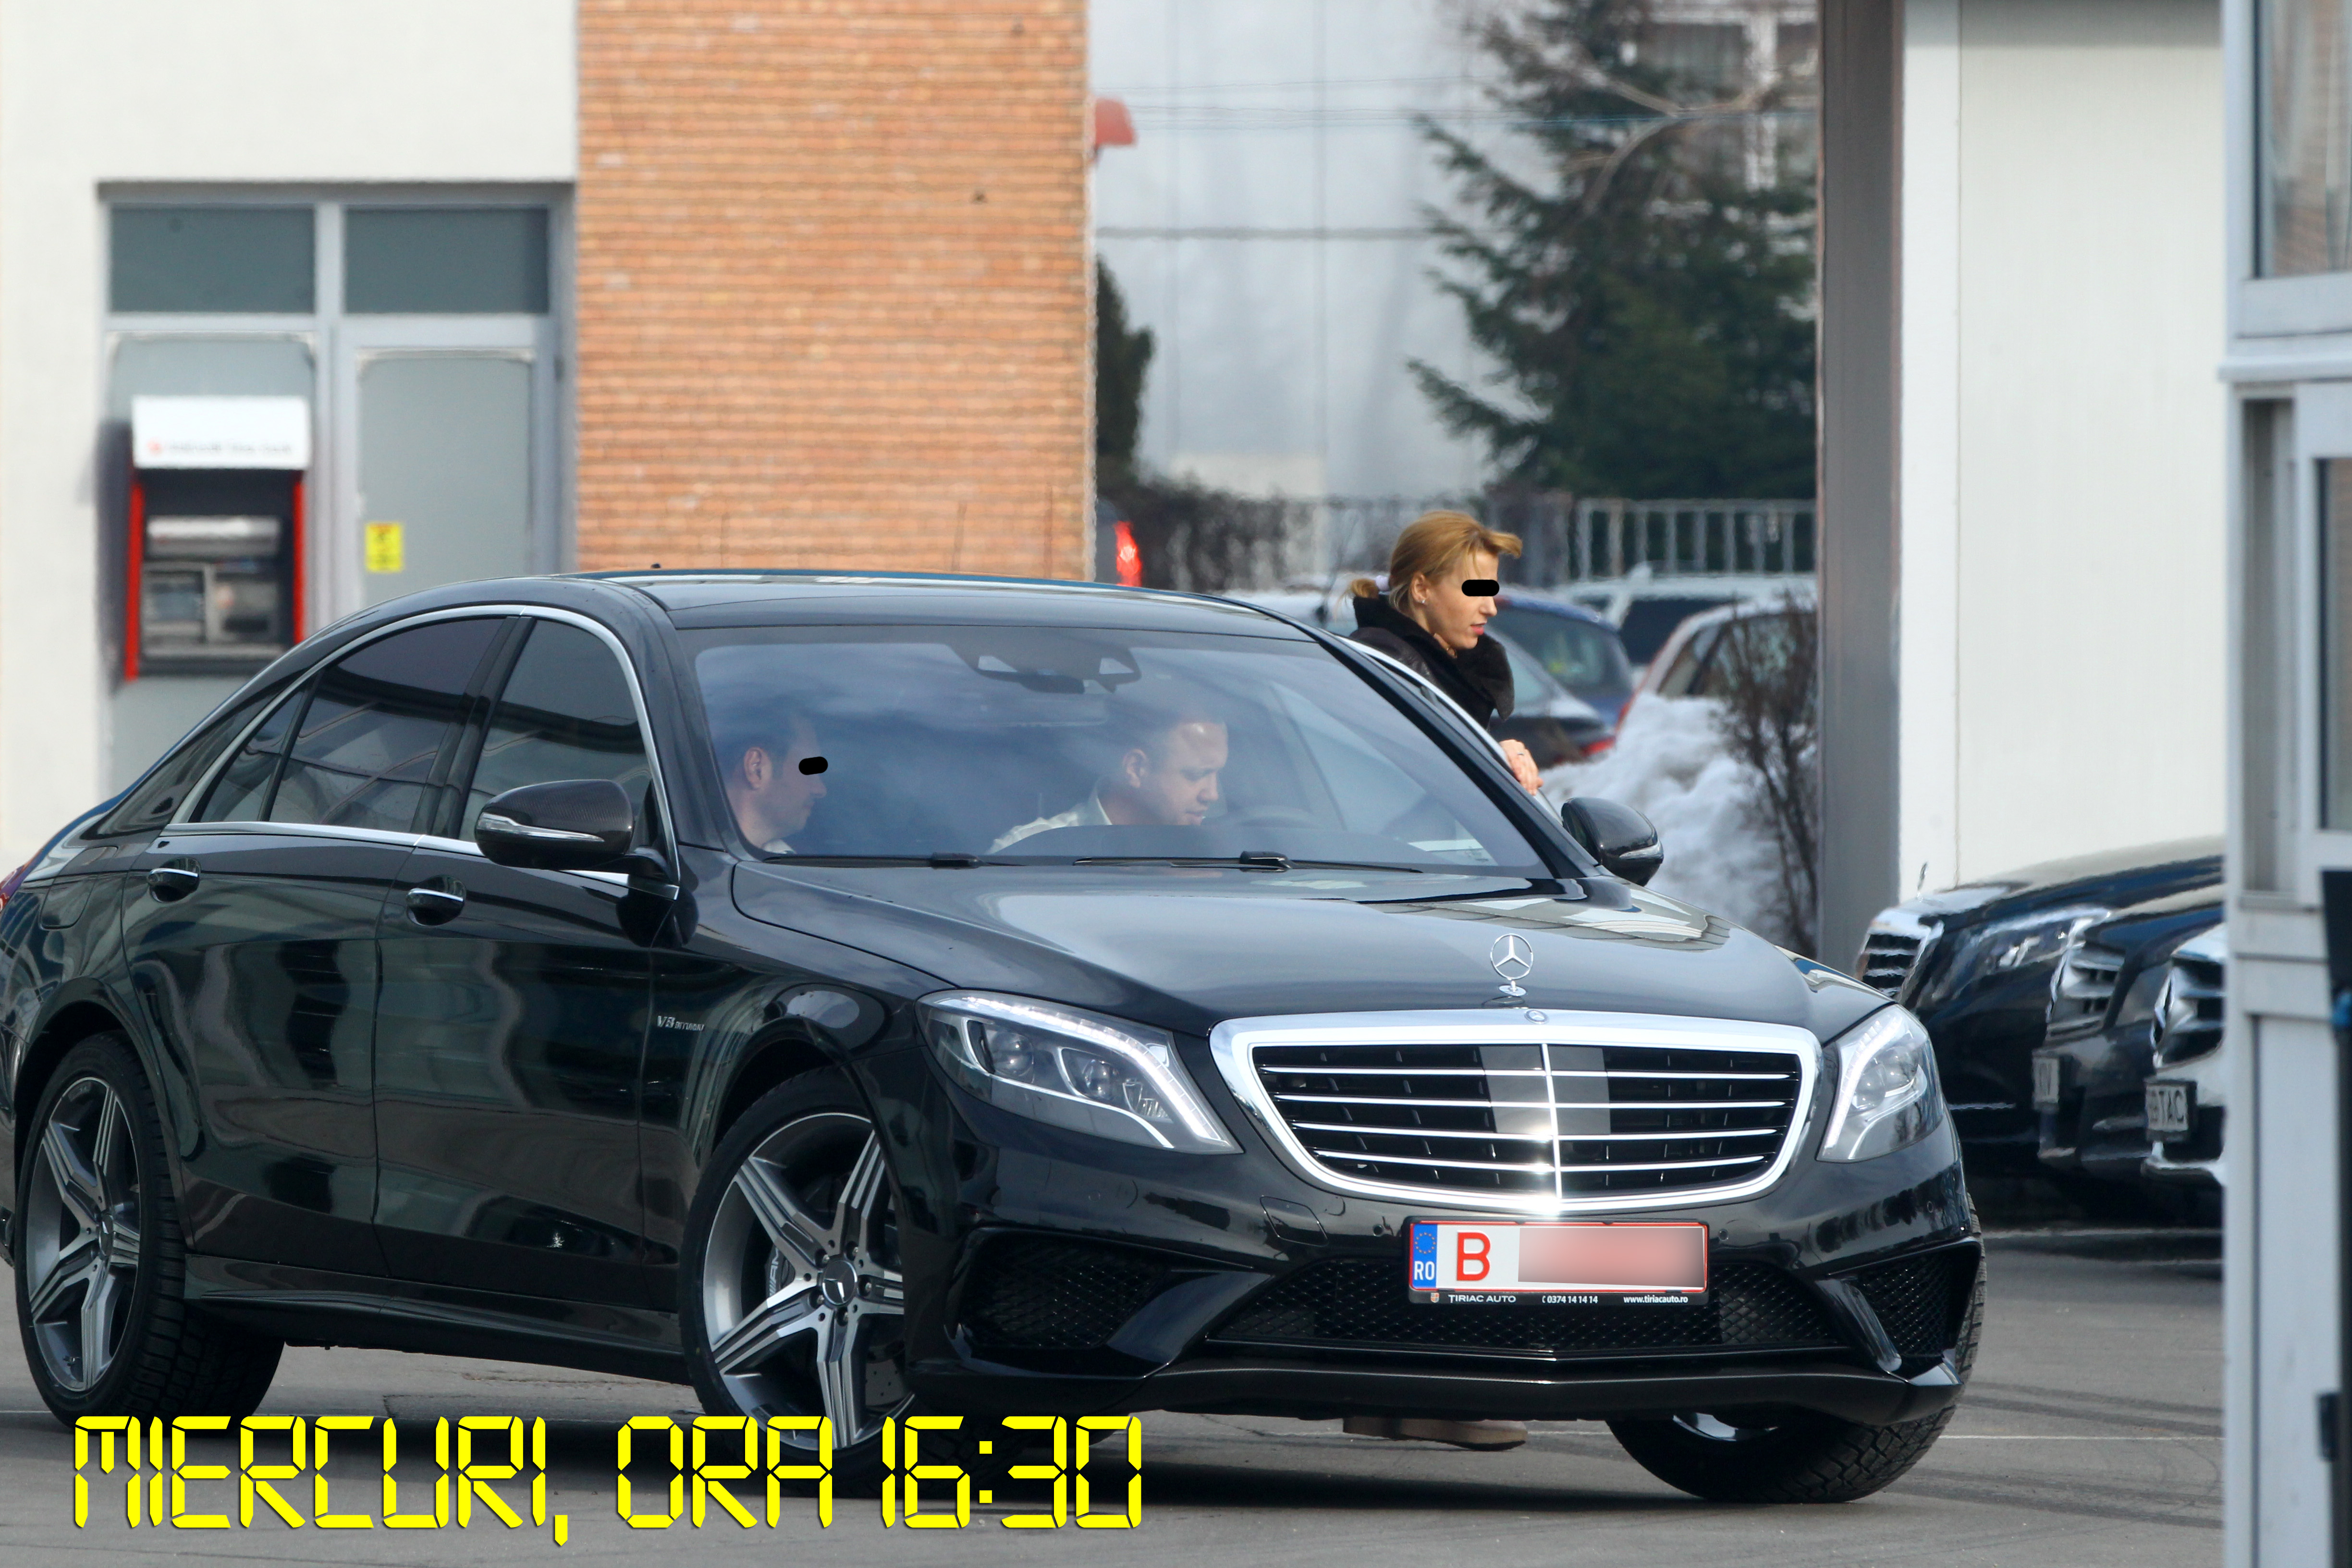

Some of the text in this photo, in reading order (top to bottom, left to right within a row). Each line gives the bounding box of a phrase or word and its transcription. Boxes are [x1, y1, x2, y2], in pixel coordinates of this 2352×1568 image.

[1456, 1231, 1491, 1281] B
[1414, 1261, 1435, 1281] RO
[1485, 1295, 1516, 1303] AUTO
[1623, 1295, 1689, 1304] www.tiriacauto.ro
